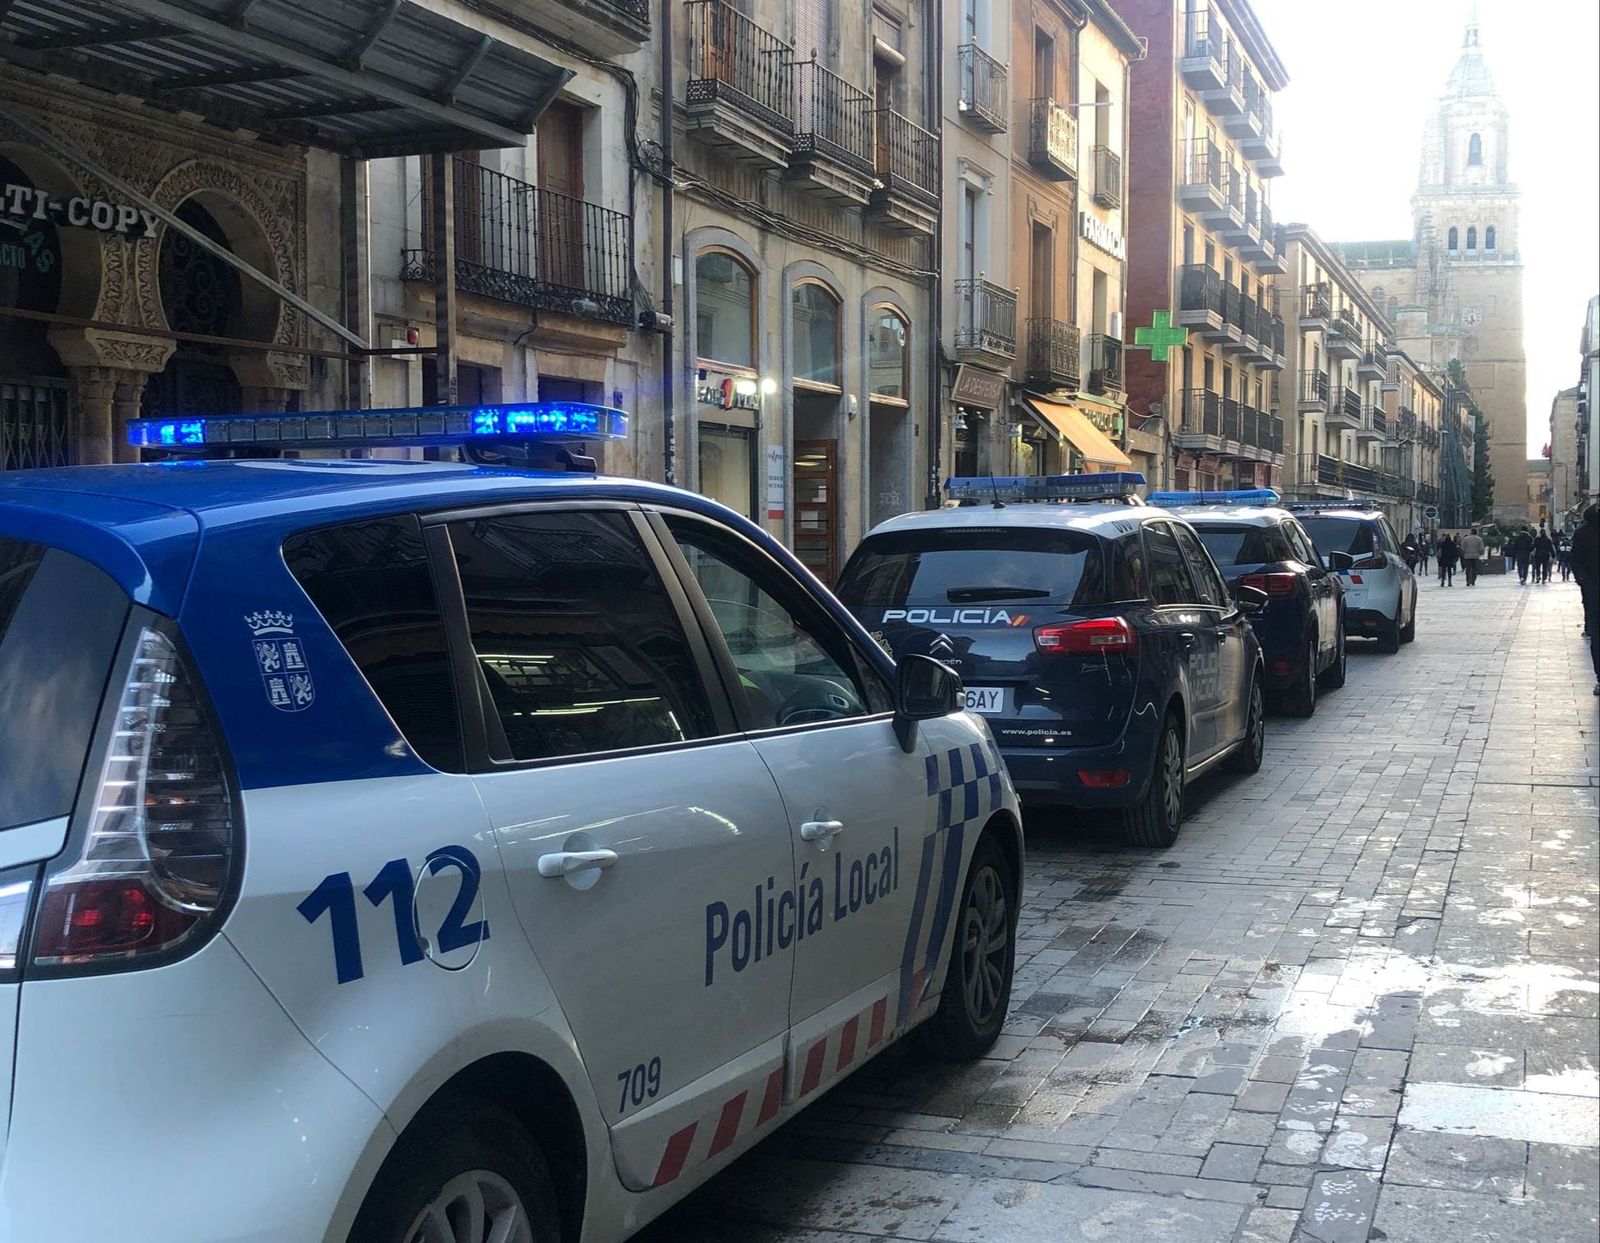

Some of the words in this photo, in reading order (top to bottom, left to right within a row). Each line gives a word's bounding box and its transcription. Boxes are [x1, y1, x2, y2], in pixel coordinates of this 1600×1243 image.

[0, 184, 160, 238] TI-COPY
[0, 243, 26, 269] CTO
[881, 607, 1012, 624] POLICÍA
[1189, 652, 1218, 677] POLIC
[965, 690, 999, 709] 6AY
[296, 844, 491, 985] 112
[704, 863, 824, 988] Policía
[834, 825, 899, 922] Local
[617, 1055, 663, 1115] 709
